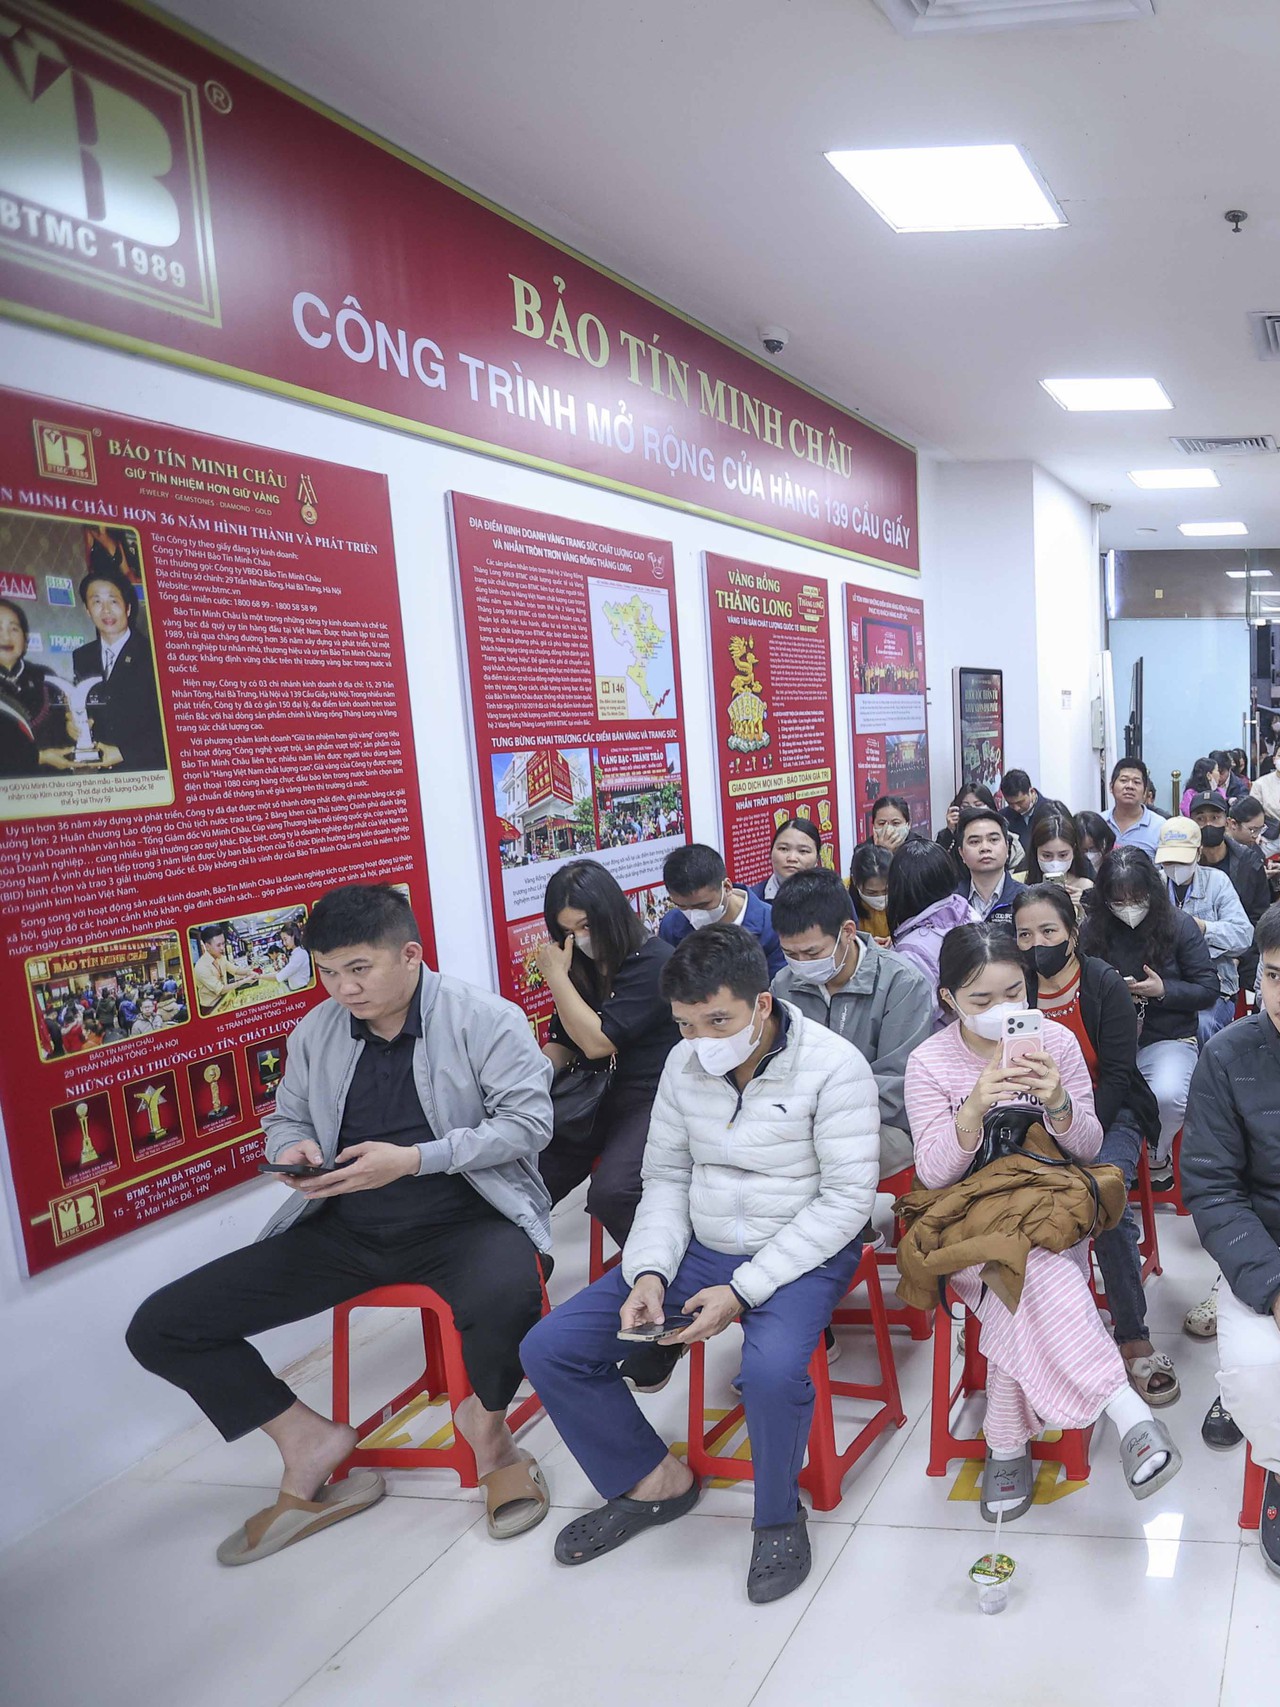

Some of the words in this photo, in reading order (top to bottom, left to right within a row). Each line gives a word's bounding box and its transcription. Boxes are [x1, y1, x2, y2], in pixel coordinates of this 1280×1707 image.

[111, 239, 185, 288] 1989
[508, 273, 611, 369] BẢO
[620, 331, 690, 408] TÍN
[699, 369, 785, 449] MINH
[788, 416, 853, 479] CHÂU
[292, 291, 446, 391] CÔNG
[459, 352, 577, 435] TRÌNH
[586, 399, 636, 453] MỞ
[644, 425, 715, 484] RỘNG
[722, 452, 766, 502] CỬA
[770, 471, 819, 519] HÀNG
[824, 497, 849, 529] 139
[852, 501, 880, 541] CẦU
[883, 509, 911, 551] GIẤY
[108, 438, 150, 461] BẢO
[154, 447, 186, 469] TÍN
[191, 456, 238, 479] MINH
[242, 466, 288, 489] CHÂU
[125, 467, 147, 480] GIỮ
[150, 471, 168, 484] TÍN
[170, 475, 204, 491] NHIỆM
[207, 482, 230, 495] HƠN
[232, 487, 251, 499] GIỮ
[253, 489, 280, 504] VÀNG
[139, 488, 169, 499] JEWELRY
[175, 493, 215, 507] GEMSTONES
[220, 502, 250, 513] DIAMOND
[255, 508, 272, 516] GOLD
[19, 490, 67, 510] MINH
[72, 498, 118, 517] CHÂU
[123, 507, 156, 522] HƠN
[160, 512, 175, 526] 36
[178, 514, 210, 531] NĂM
[214, 519, 247, 536] HÌNH
[250, 525, 293, 543] THÀNH
[296, 531, 312, 546] VÀ
[315, 535, 344, 550] PHÁT
[346, 540, 378, 555] TRIỂN
[469, 517, 483, 531] ĐỊA
[484, 519, 503, 533] ĐIỂM
[504, 526, 522, 537] KINH
[523, 528, 546, 542] DOANH
[547, 532, 564, 546] VÀNG
[565, 537, 586, 550] TRANG
[587, 539, 599, 551] SỨC
[599, 543, 613, 555] CHẤT
[614, 547, 632, 560] LƯỢNG
[633, 550, 645, 561] CAO
[493, 538, 502, 549] VÀ
[503, 541, 524, 554] NHẪN
[525, 545, 543, 557] TRÒN
[544, 548, 561, 559] TRƠN
[562, 551, 579, 564] VÀNG
[579, 554, 597, 567] RỒNG
[597, 557, 616, 570] THĂNG
[617, 561, 633, 573] LONG
[728, 569, 754, 588] VÀNG
[757, 572, 781, 593] RỒNG
[716, 589, 760, 613] THĂNG
[763, 597, 793, 618] LONG
[612, 682, 625, 694] 146
[491, 737, 514, 748] TƯNG
[514, 733, 536, 746] BỪNG
[537, 734, 554, 745] KHAI
[554, 733, 582, 744] TRƯƠNG
[582, 730, 595, 742] CÁC
[595, 729, 611, 741] ĐIỂM
[612, 729, 624, 740] BÁN
[624, 728, 640, 740] VÀNG
[640, 728, 648, 740] VÀ
[648, 730, 666, 740] TRANG
[666, 728, 677, 739] SỨC
[732, 781, 747, 793] GIAO
[748, 779, 762, 792] DỊCH
[762, 778, 773, 790] MỌI
[774, 776, 784, 786] NƠI
[787, 772, 798, 785] BẢO
[799, 771, 812, 783] TOÀN
[812, 770, 821, 781] GIÁ
[736, 796, 752, 811] NHẪN
[753, 795, 767, 809] TRÒN
[768, 793, 784, 806] TRƠN
[53, 960, 78, 974] BẢO
[79, 957, 99, 970] TÍN
[101, 954, 127, 967] MINH
[128, 950, 148, 963] CHÂU
[65, 1070, 75, 1079] 29
[100, 1058, 122, 1071] NHÂN
[123, 1051, 148, 1065] TÔNG
[153, 1045, 166, 1057] HÀ
[168, 1039, 179, 1053] NỘI
[66, 1075, 114, 1099] NHỮNG
[117, 1063, 145, 1083] GIẢI
[147, 1045, 197, 1072] THƯỞNG
[199, 1042, 215, 1058] UY
[216, 1035, 238, 1052] TÍN,
[240, 1025, 268, 1044] CHẤT
[89, 1052, 105, 1061] BẢO
[106, 1048, 117, 1059] TÍN
[117, 1044, 135, 1056] MINH
[136, 1038, 155, 1051] CHÂU
[127, 1186, 151, 1202] BTMC
[156, 1177, 171, 1190] HAI
[171, 1171, 184, 1184] BÀ
[185, 1160, 212, 1179] TRƯNG
[135, 1199, 146, 1210] 29
[148, 1189, 167, 1204] Trần
[168, 1183, 189, 1198] Nhân
[214, 1165, 227, 1177] HN
[137, 1211, 142, 1220] 4
[144, 1204, 160, 1219] Mai
[162, 1197, 179, 1214] Hắc
[197, 1183, 210, 1195] HN
